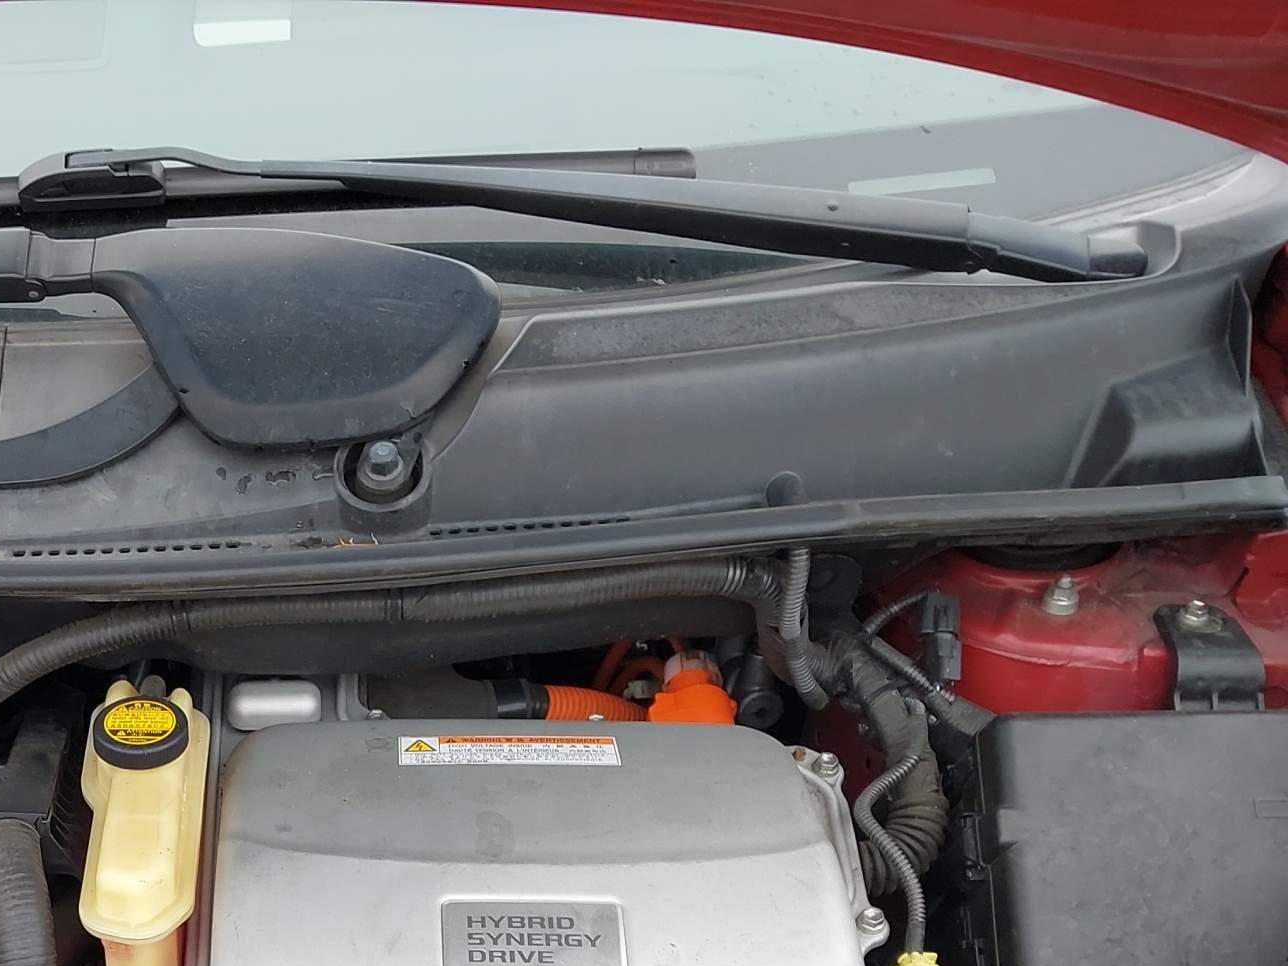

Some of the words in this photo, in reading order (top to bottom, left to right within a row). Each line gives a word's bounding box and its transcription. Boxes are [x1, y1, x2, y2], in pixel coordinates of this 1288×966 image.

[467, 916, 574, 929] HYBRID
[467, 932, 601, 947] SYNERGY
[468, 950, 555, 963] DRIVE
